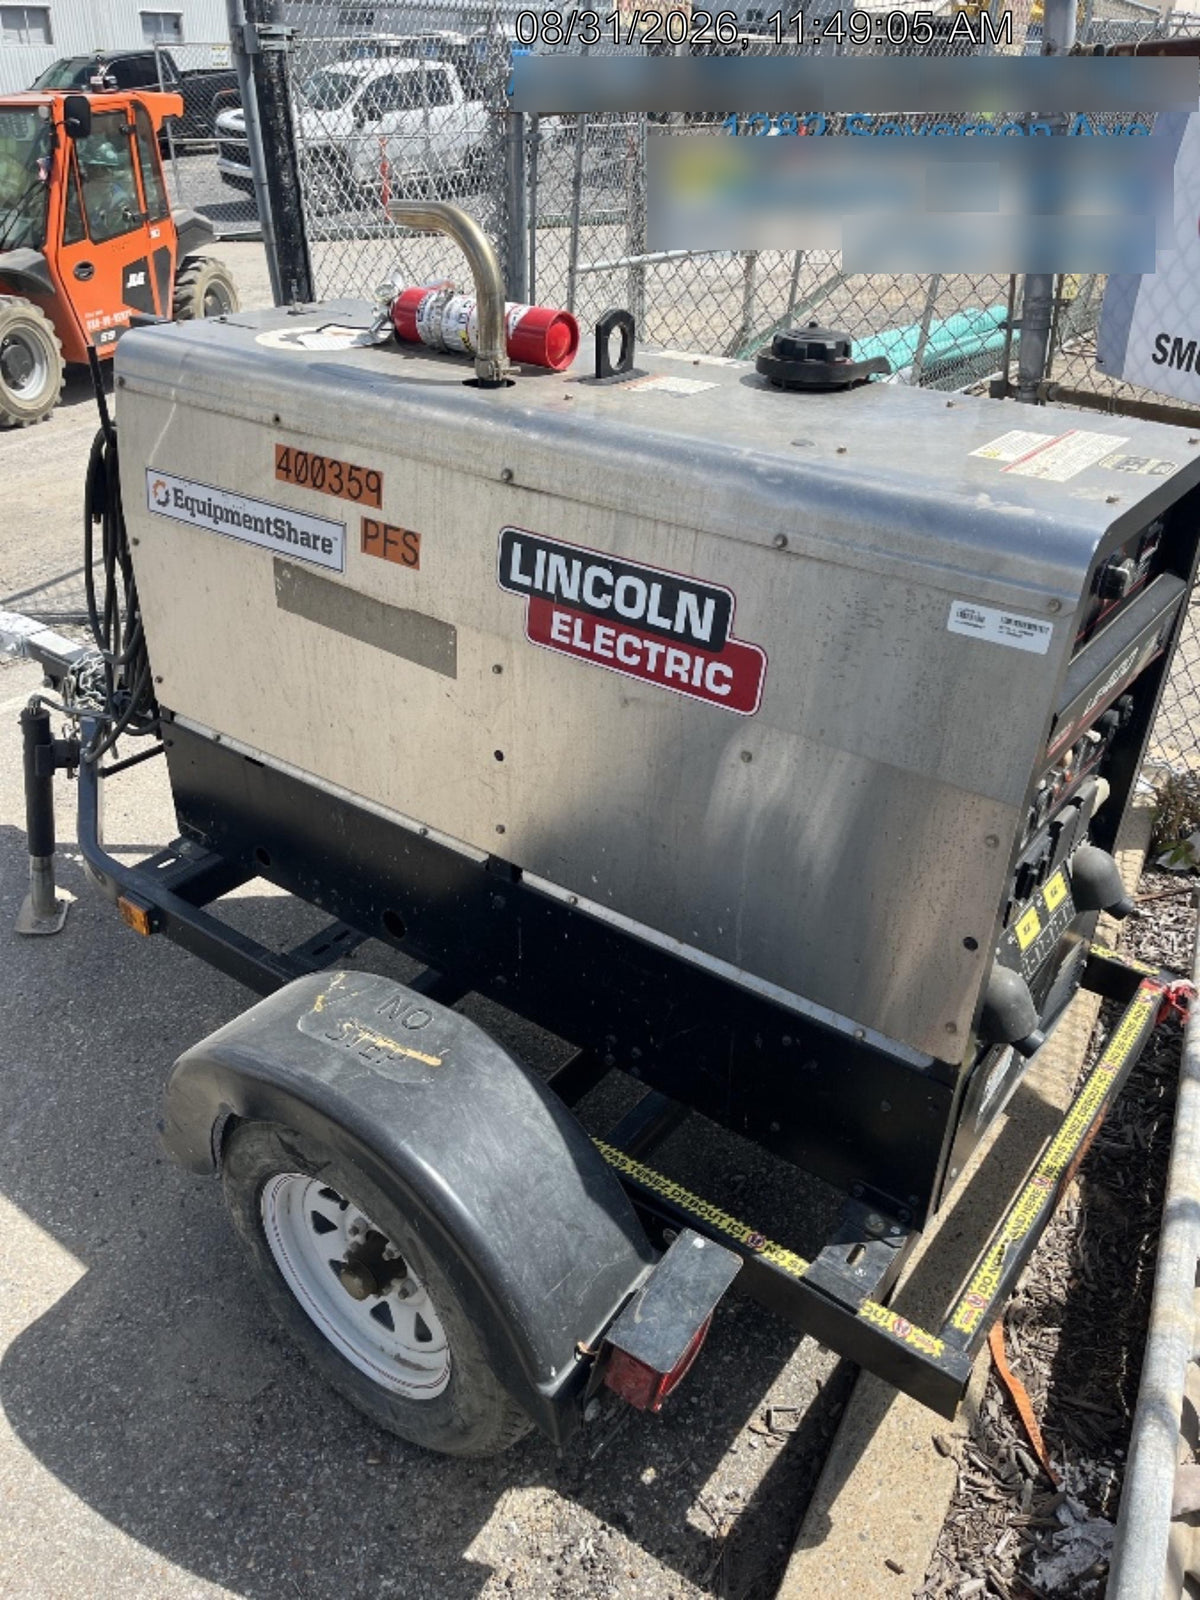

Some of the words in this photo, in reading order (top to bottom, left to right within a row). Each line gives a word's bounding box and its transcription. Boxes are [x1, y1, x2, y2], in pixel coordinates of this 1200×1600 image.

[277, 447, 381, 506] 400359
[363, 519, 419, 566] PFS
[509, 542, 716, 643] LINCOLN
[550, 610, 733, 697] ELECTRIC
[376, 995, 434, 1031] NO
[670, 1187, 726, 1225] DEBOUT
[726, 1220, 746, 1236] ICI
[764, 1243, 786, 1262] NO
[976, 1274, 993, 1294] DO
